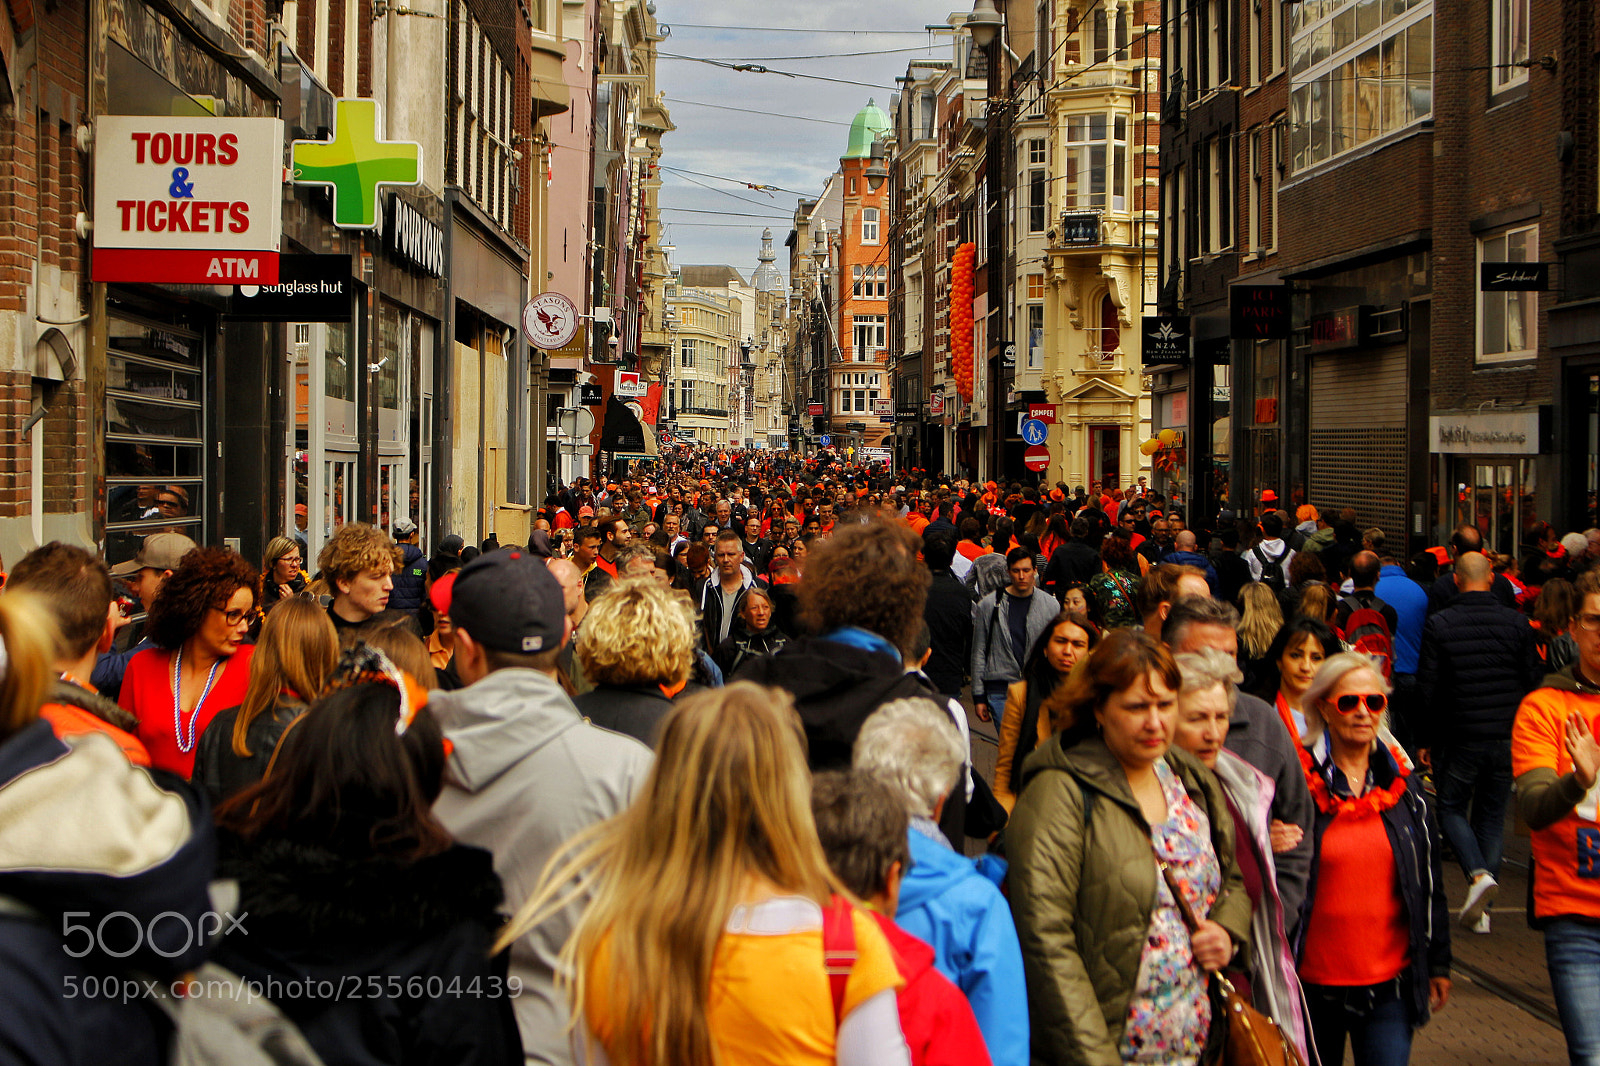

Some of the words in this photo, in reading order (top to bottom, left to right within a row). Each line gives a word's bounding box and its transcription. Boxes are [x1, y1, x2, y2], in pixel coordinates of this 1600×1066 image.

[131, 132, 239, 166] TOURS
[169, 167, 194, 199] &
[116, 200, 250, 234] TICKETS
[206, 258, 259, 278] ATM
[262, 279, 318, 297] sunglass
[320, 279, 343, 294] hut
[1252, 289, 1273, 301] ICI
[532, 297, 572, 313] SEASONS
[1242, 306, 1283, 318] PARIS
[1031, 409, 1054, 418] CAMPER
